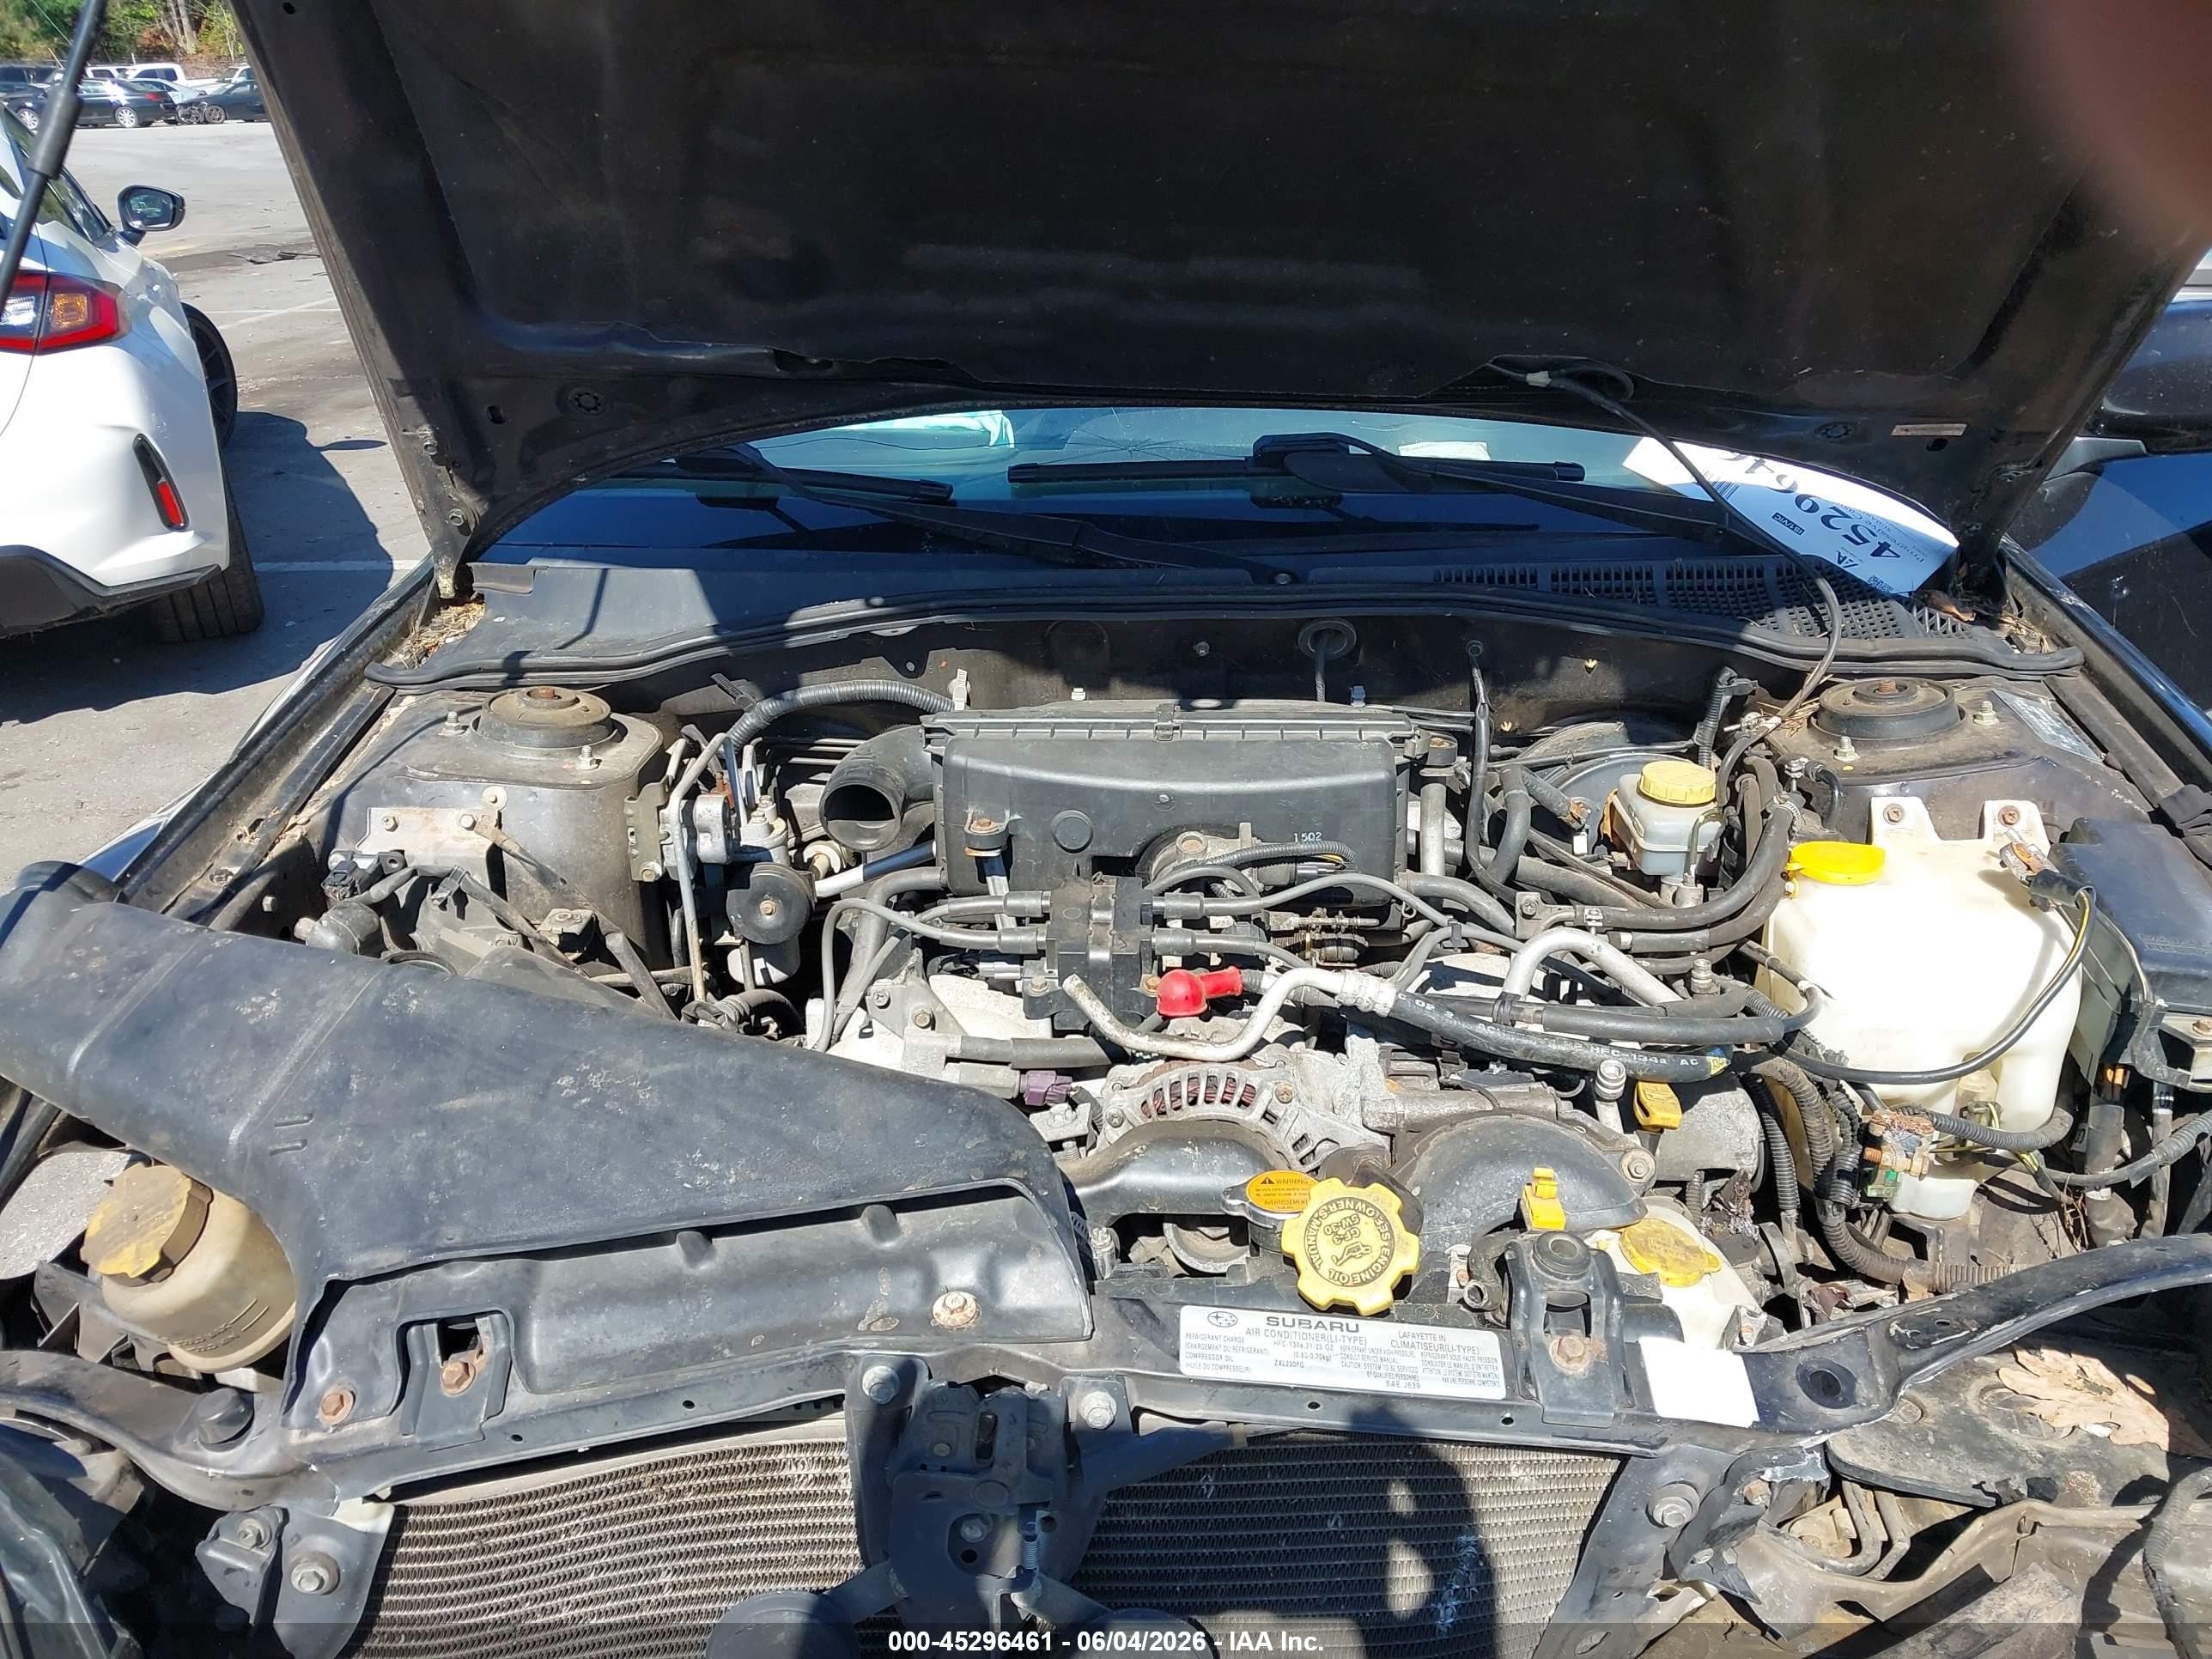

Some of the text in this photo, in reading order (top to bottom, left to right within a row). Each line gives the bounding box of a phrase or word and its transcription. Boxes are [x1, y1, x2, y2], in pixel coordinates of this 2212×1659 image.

[1323, 1213, 1360, 1235] 5W-30
[1374, 1214, 1391, 1242] SEE
[1306, 1213, 1323, 1270] MANUAL
[1328, 1245, 1391, 1285] ENGINE OIL
[1267, 1316, 1359, 1333] SUBARU
[1399, 1331, 1437, 1341] LAFAYETTE
